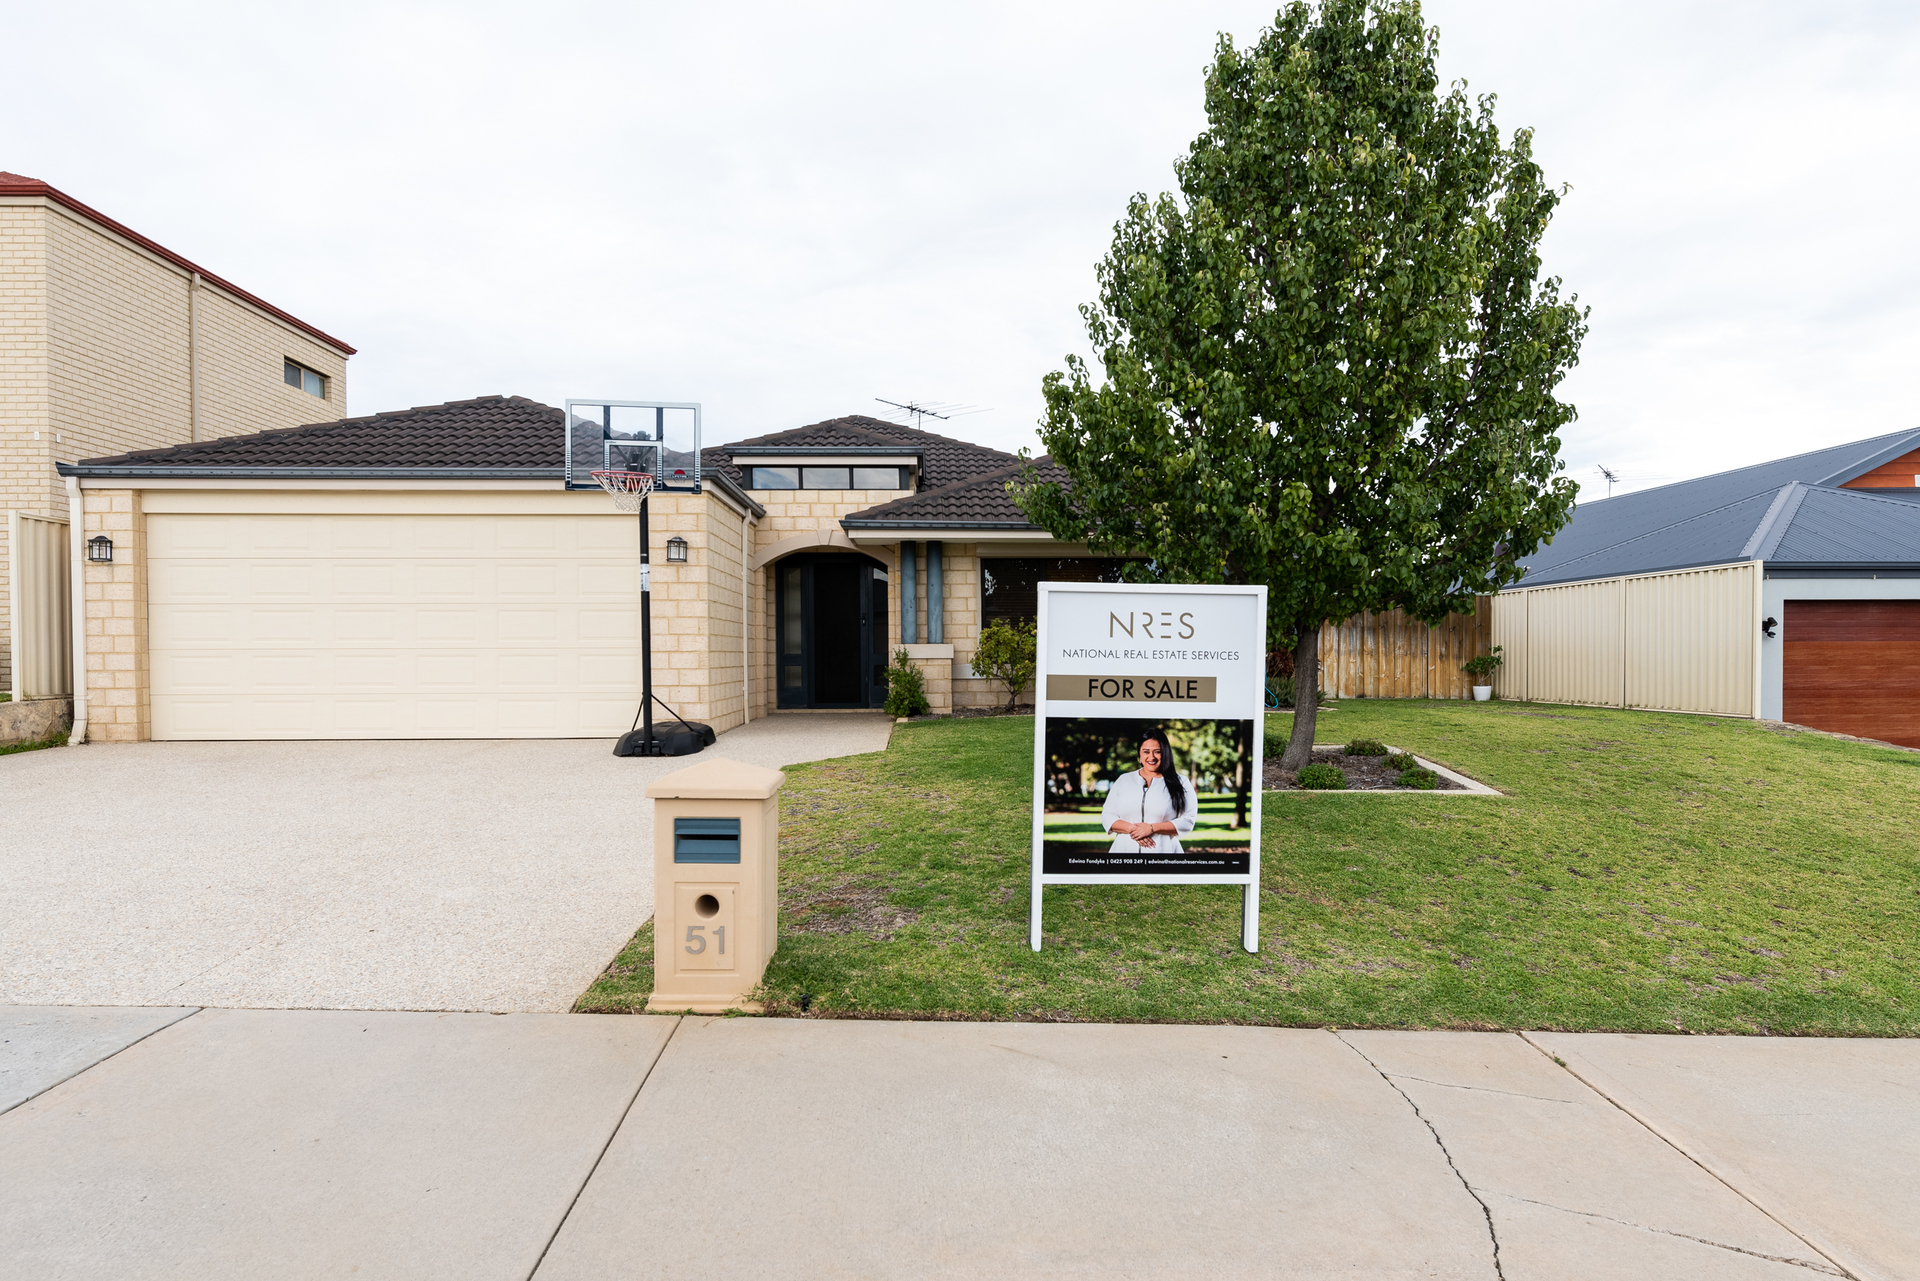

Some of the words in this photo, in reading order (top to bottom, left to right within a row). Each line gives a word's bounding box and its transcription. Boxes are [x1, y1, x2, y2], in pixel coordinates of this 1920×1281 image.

[1109, 610, 1195, 640] NRES
[1062, 648, 1120, 659] NATIONAL
[1123, 649, 1149, 660] REAL
[1152, 650, 1188, 660] ESTATE
[1191, 650, 1240, 661] SERVICES
[1088, 678, 1135, 699] FOR
[1143, 679, 1198, 700] SALE
[1068, 857, 1086, 865] Edwina
[684, 925, 726, 955] 51
